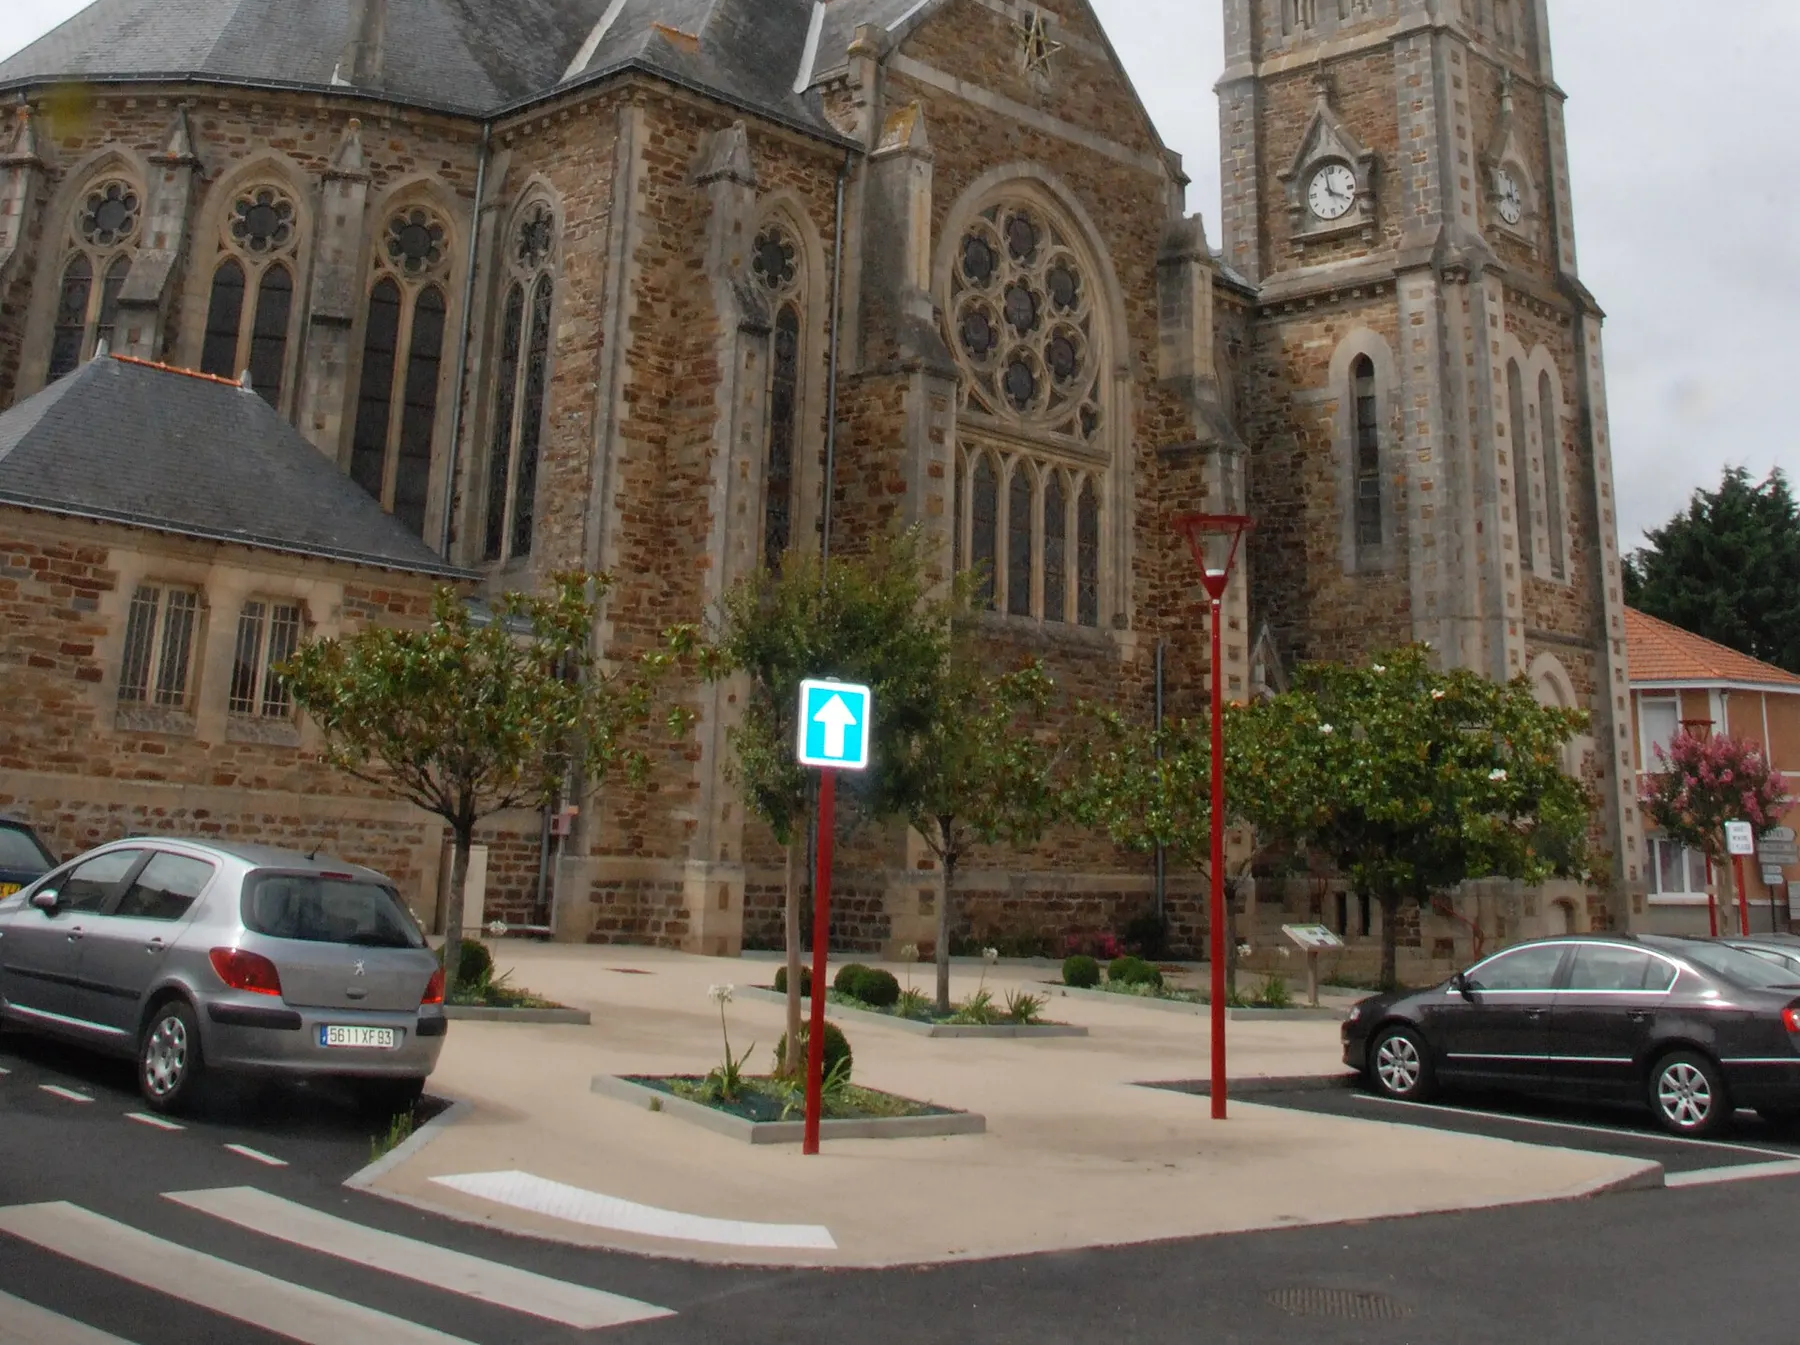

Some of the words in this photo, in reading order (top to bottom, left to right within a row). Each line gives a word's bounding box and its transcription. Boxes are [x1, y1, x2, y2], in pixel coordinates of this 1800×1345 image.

[329, 1028, 358, 1042] 5611
[362, 1029, 375, 1044] XF
[377, 1030, 391, 1045] 93
